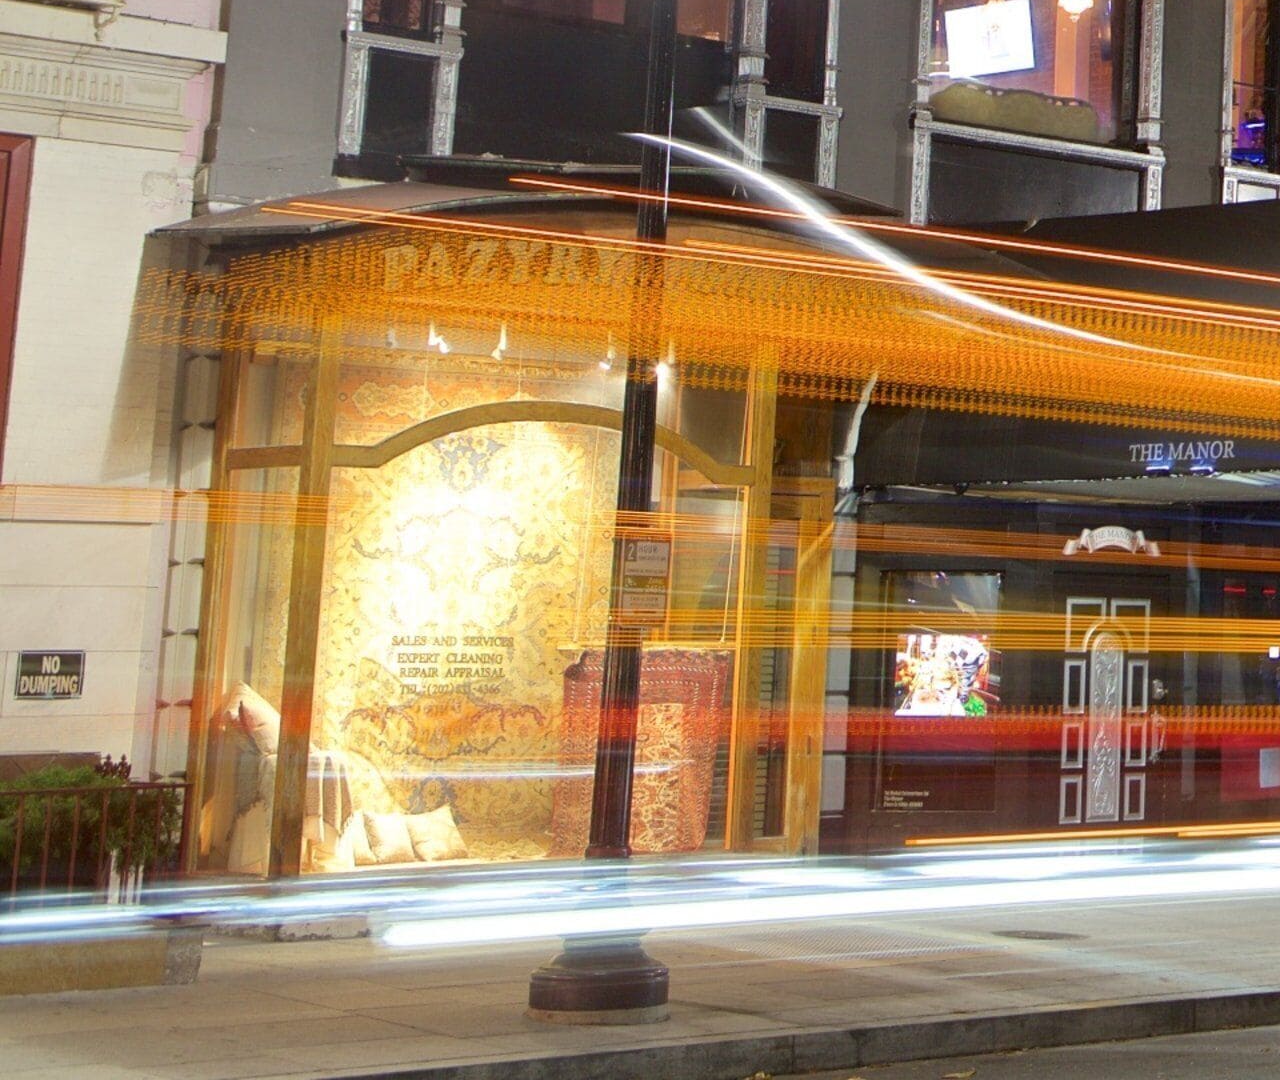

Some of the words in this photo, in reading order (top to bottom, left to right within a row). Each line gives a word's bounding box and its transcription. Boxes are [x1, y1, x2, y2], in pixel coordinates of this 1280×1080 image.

[1129, 443, 1163, 462] THE
[1168, 440, 1235, 461] MANOR
[392, 635, 428, 646] SALES
[433, 636, 457, 646] AND
[463, 636, 514, 647] SERVICES
[42, 655, 60, 674] NO
[398, 653, 440, 663] EXPERT
[446, 653, 503, 664] CLEANING
[400, 667, 439, 677] REPAIR
[445, 667, 506, 678] APPRAISAL
[20, 675, 78, 694] DUMPING
